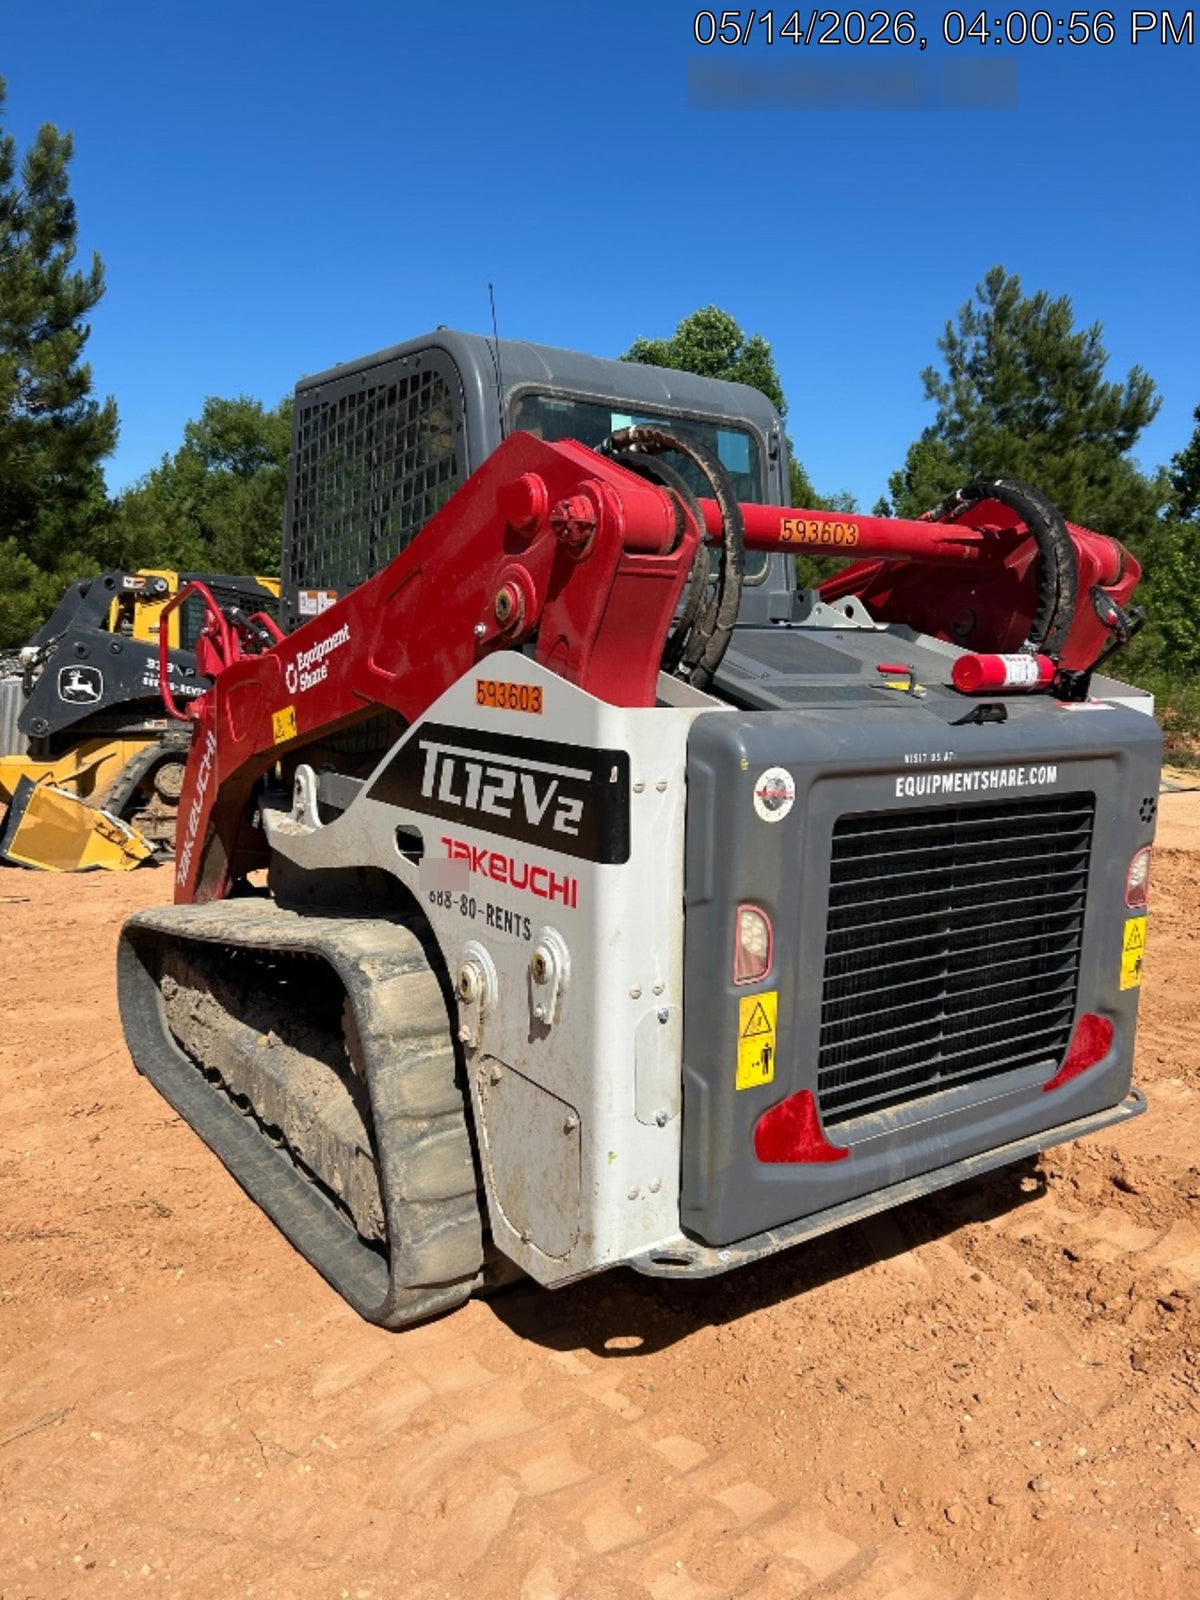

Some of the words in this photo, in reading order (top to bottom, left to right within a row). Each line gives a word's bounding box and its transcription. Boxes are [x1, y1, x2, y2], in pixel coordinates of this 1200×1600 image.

[782, 519, 857, 545] 593603
[296, 622, 351, 671] Equipment
[300, 664, 328, 692] Share
[476, 679, 543, 713] 593603
[904, 753, 928, 764] VISIT
[930, 752, 942, 762] US
[418, 739, 593, 837] TL12V2
[895, 765, 1058, 798] EQUIPMENTSHARE.COM
